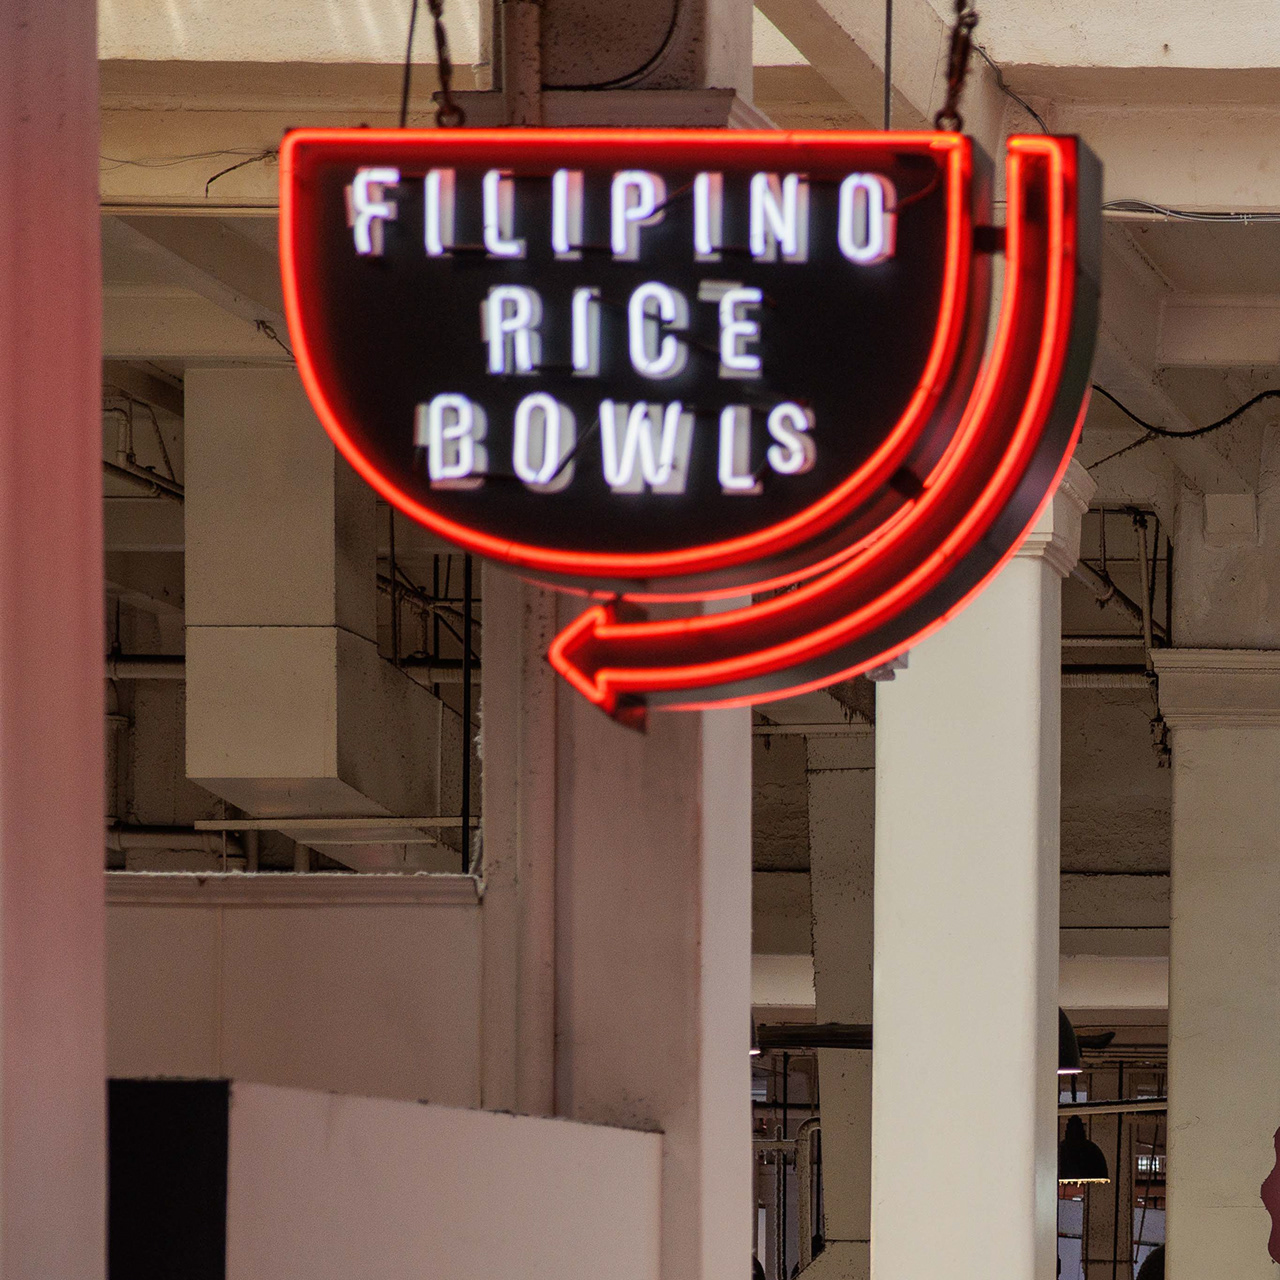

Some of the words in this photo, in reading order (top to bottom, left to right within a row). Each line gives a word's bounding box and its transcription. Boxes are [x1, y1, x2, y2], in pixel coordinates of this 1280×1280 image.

[346, 168, 896, 263] FILIPINO
[482, 281, 765, 378] RICE
[415, 393, 815, 493] BOWLS
